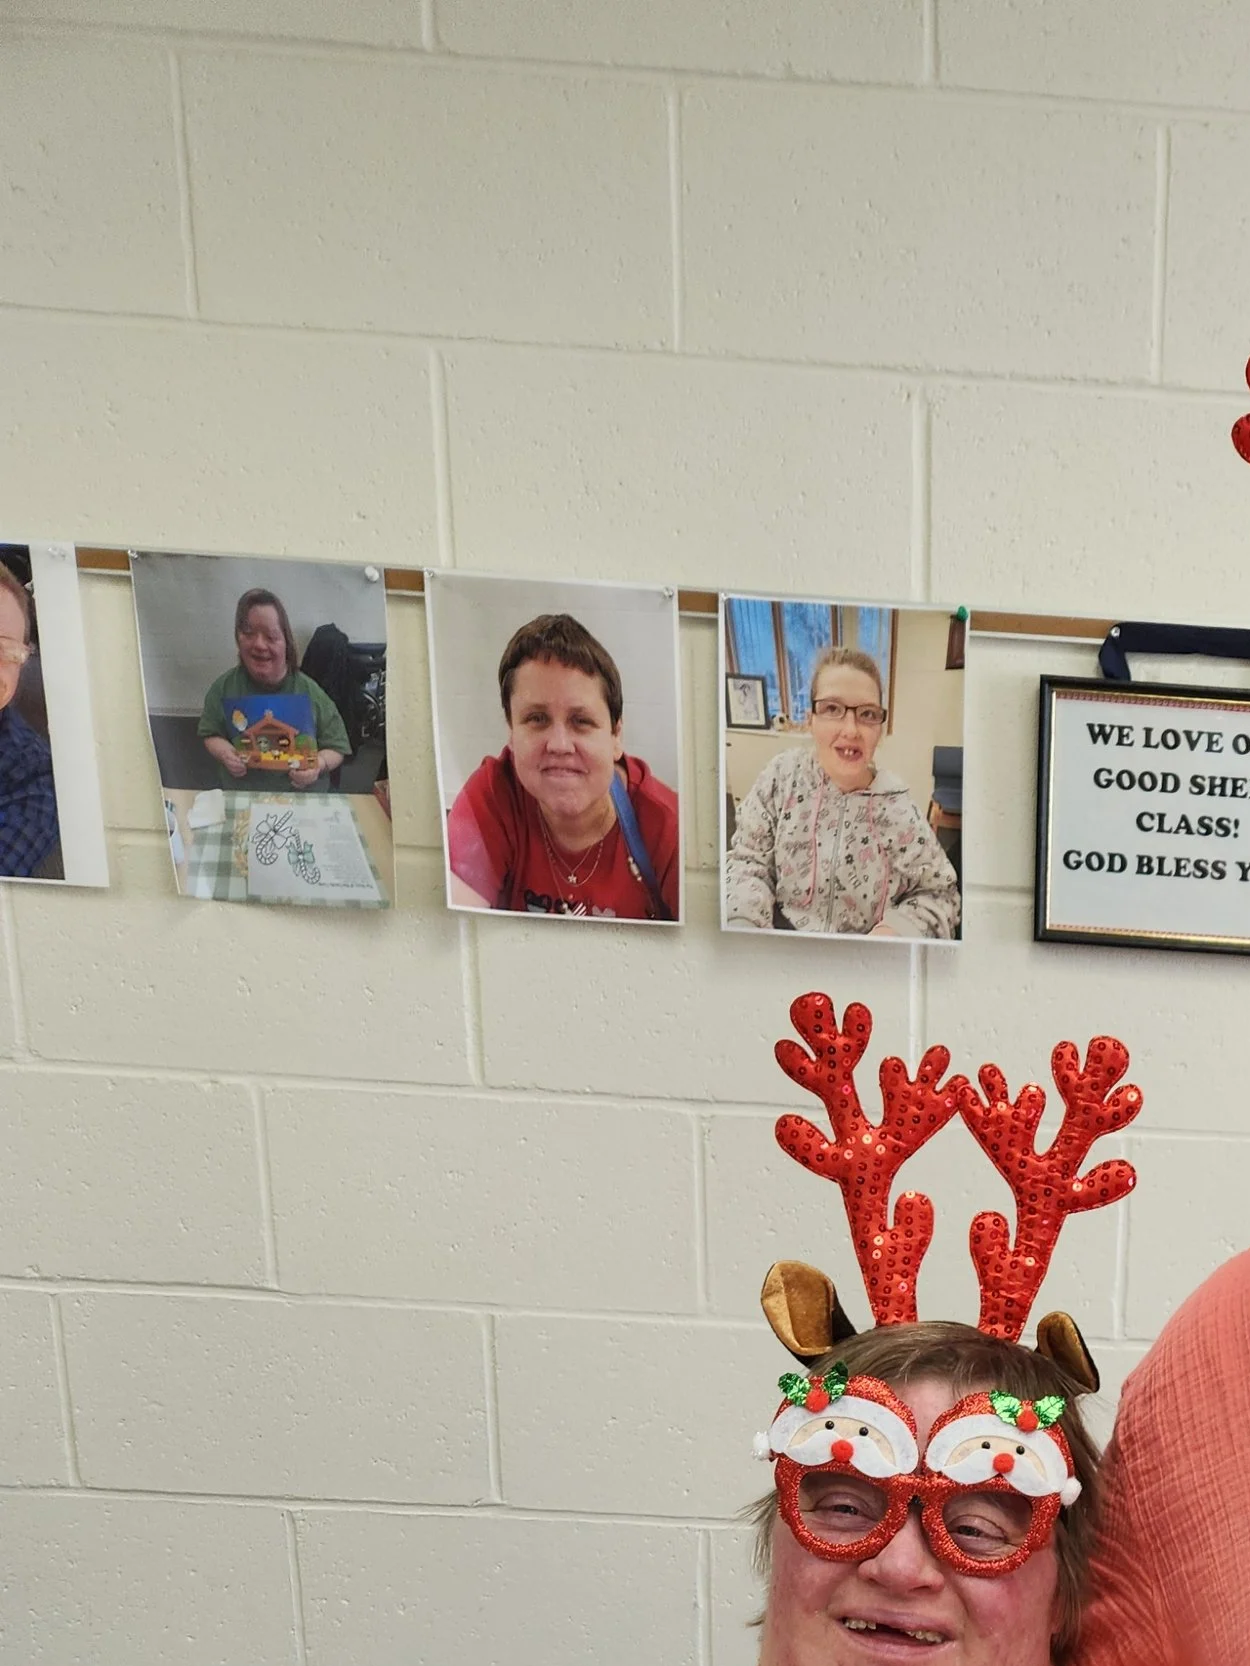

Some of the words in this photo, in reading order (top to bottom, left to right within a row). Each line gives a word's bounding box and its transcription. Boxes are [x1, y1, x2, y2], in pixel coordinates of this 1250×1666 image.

[1086, 722, 1135, 747] WE
[1142, 726, 1224, 754] LOVE
[1092, 767, 1181, 794] GOOD
[1135, 811, 1241, 838] CLASS!
[1062, 849, 1128, 874] GOD
[1135, 854, 1227, 881] BLESS
